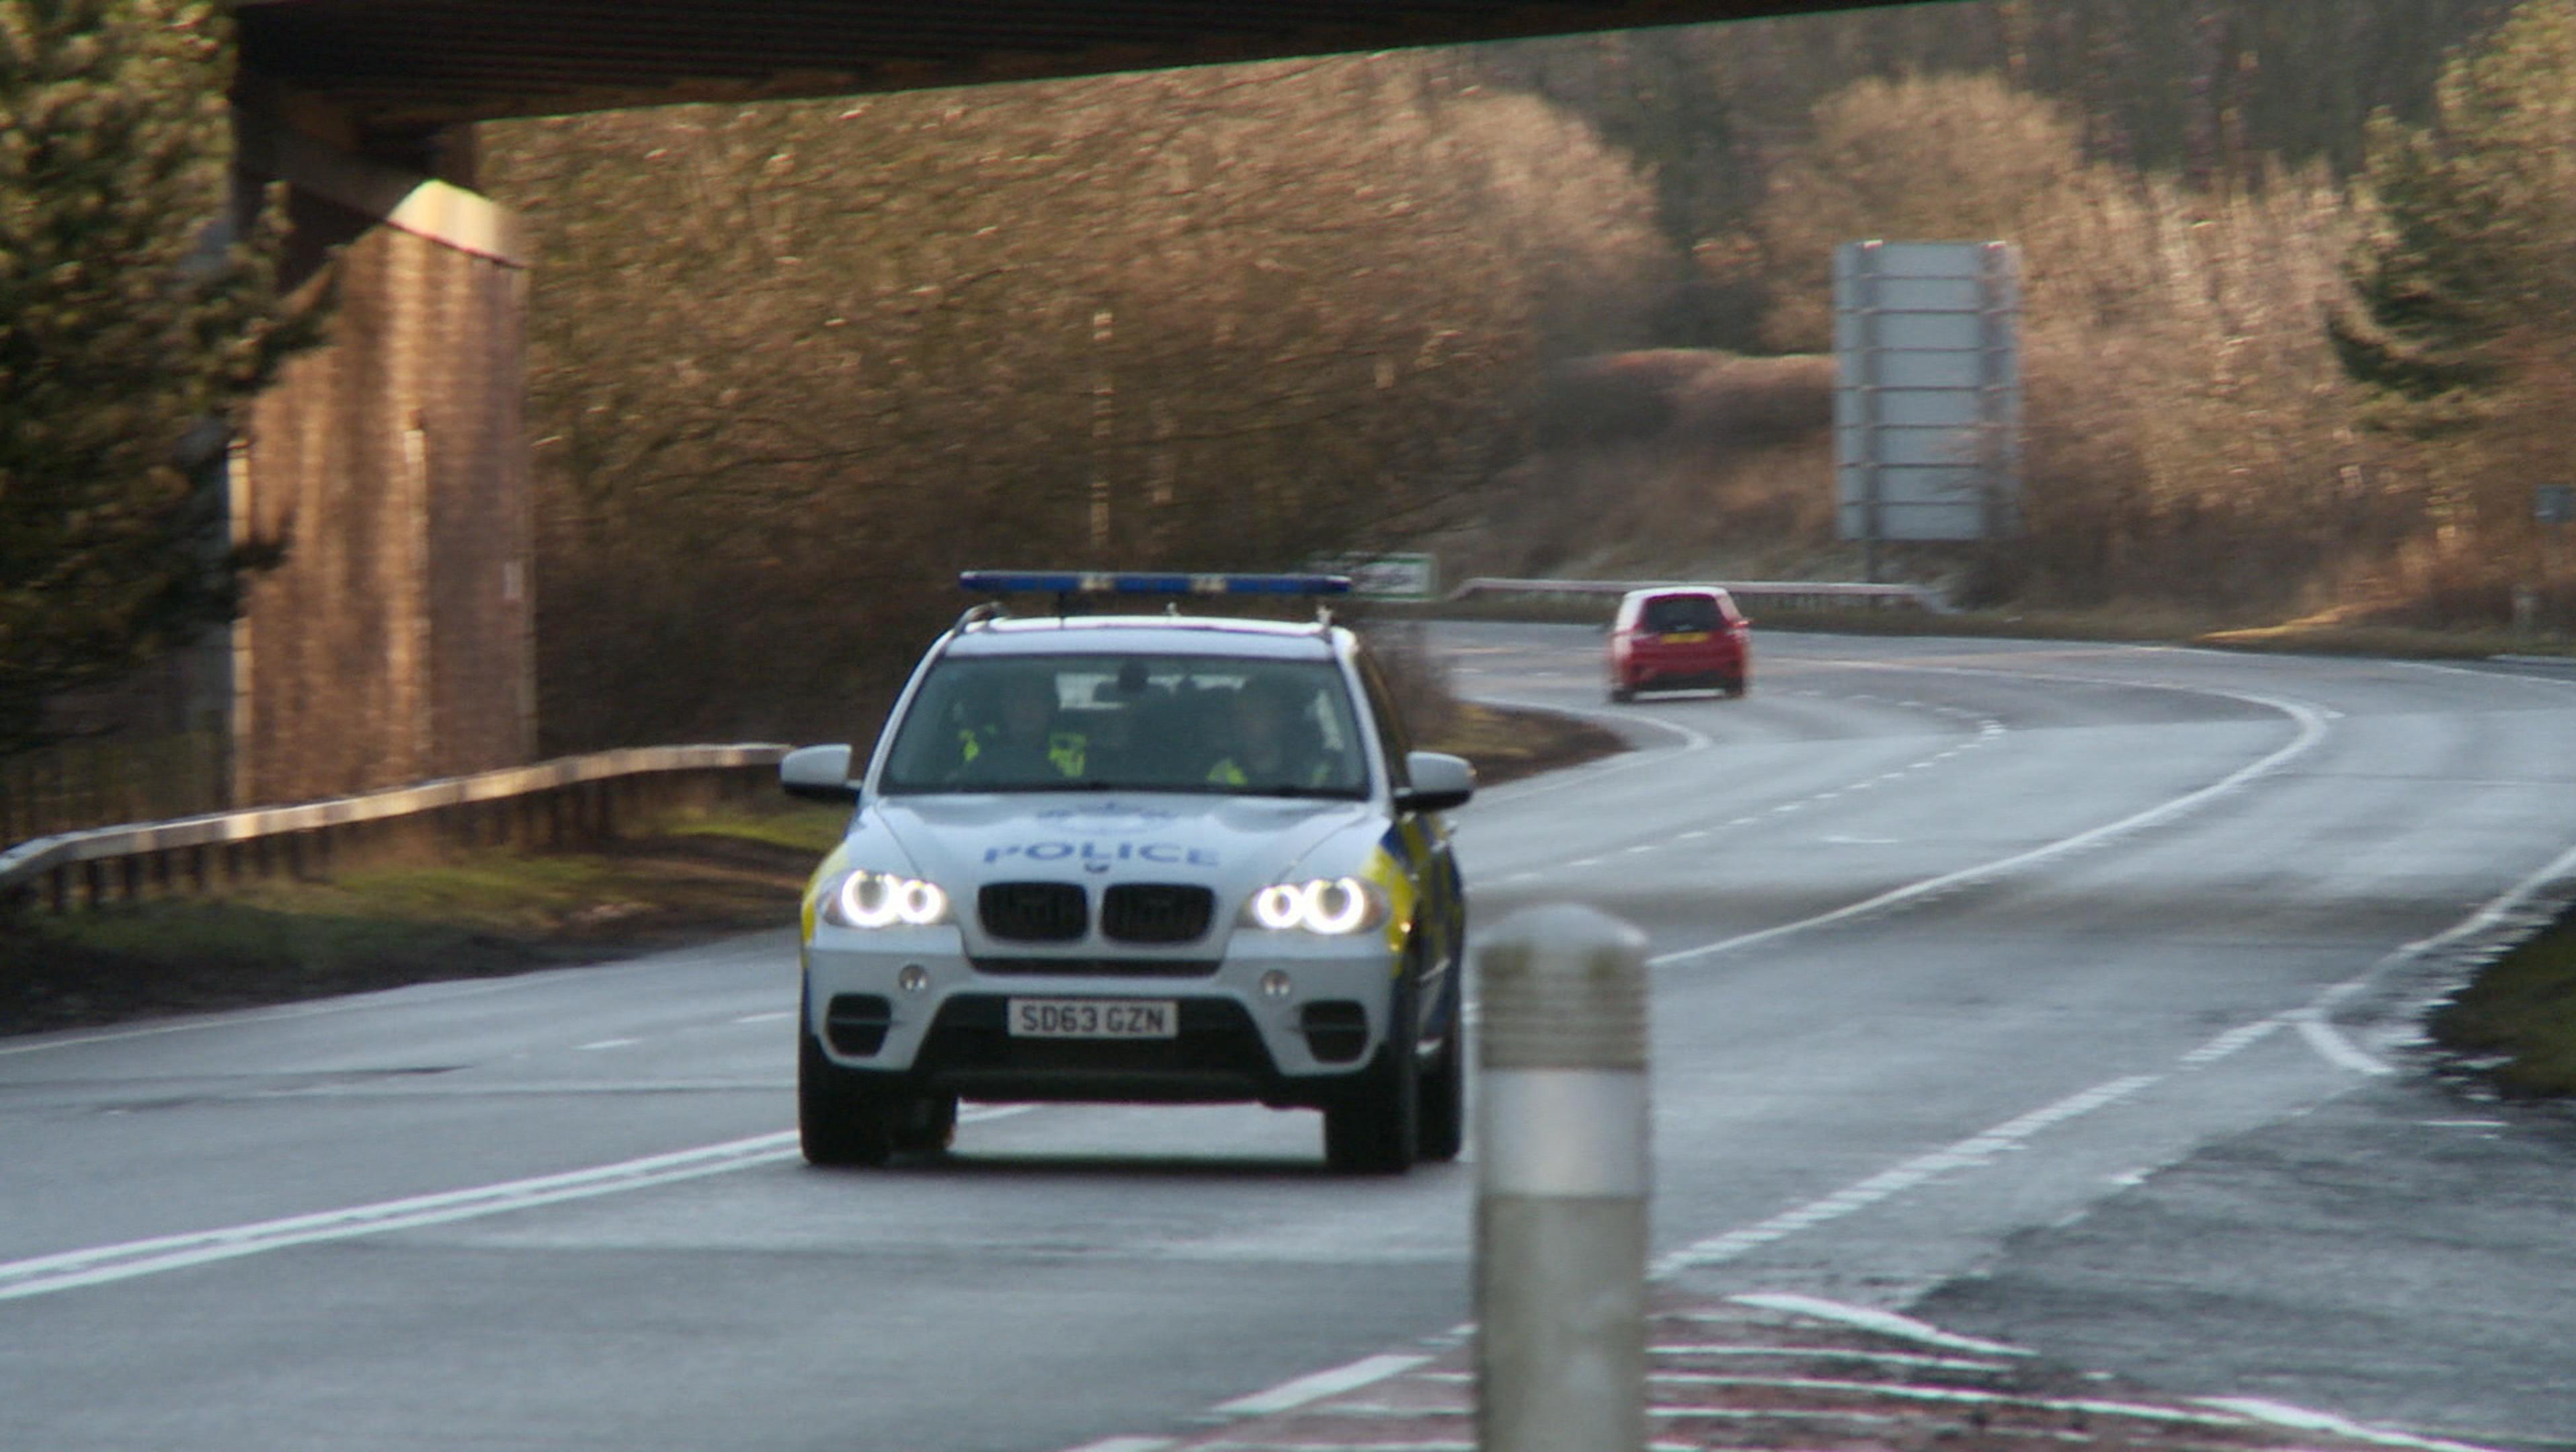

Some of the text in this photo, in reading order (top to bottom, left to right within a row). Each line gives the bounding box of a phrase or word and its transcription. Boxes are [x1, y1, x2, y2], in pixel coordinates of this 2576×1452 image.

[983, 841, 1219, 866] POLICE
[1020, 1005, 1164, 1033] SD63 GZN
